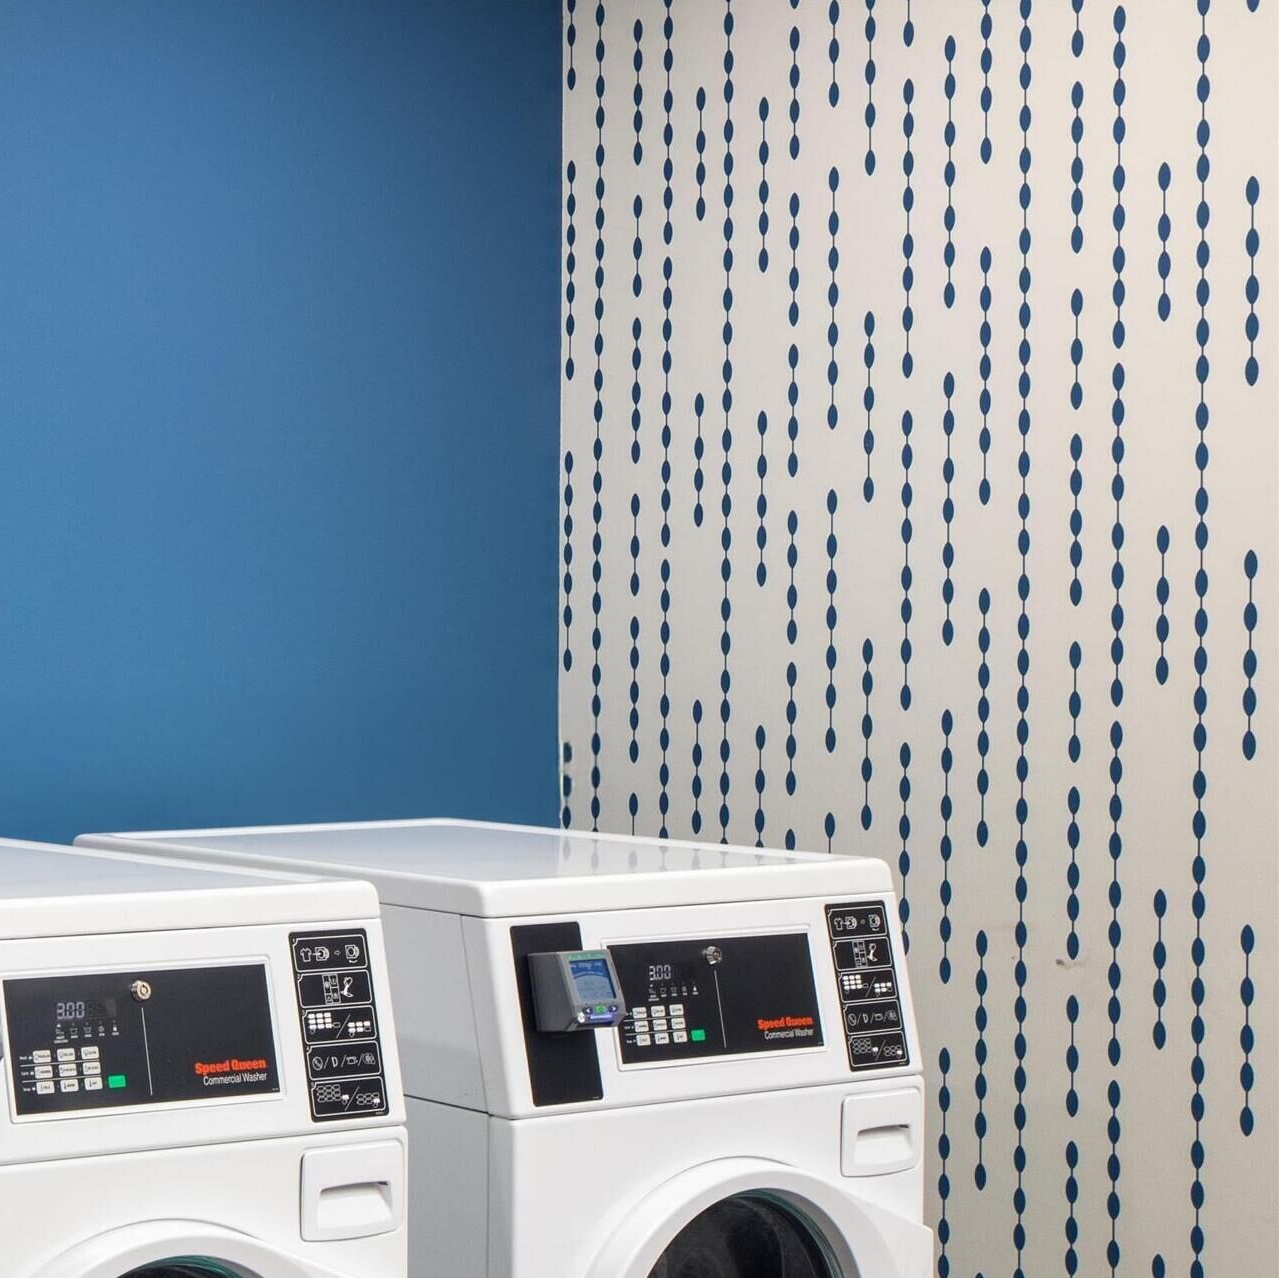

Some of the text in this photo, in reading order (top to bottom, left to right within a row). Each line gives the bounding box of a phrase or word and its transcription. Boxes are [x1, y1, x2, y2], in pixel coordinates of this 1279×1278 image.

[194, 1059, 267, 1075] Speed Queen
[203, 1072, 267, 1086] Commercial Washer
